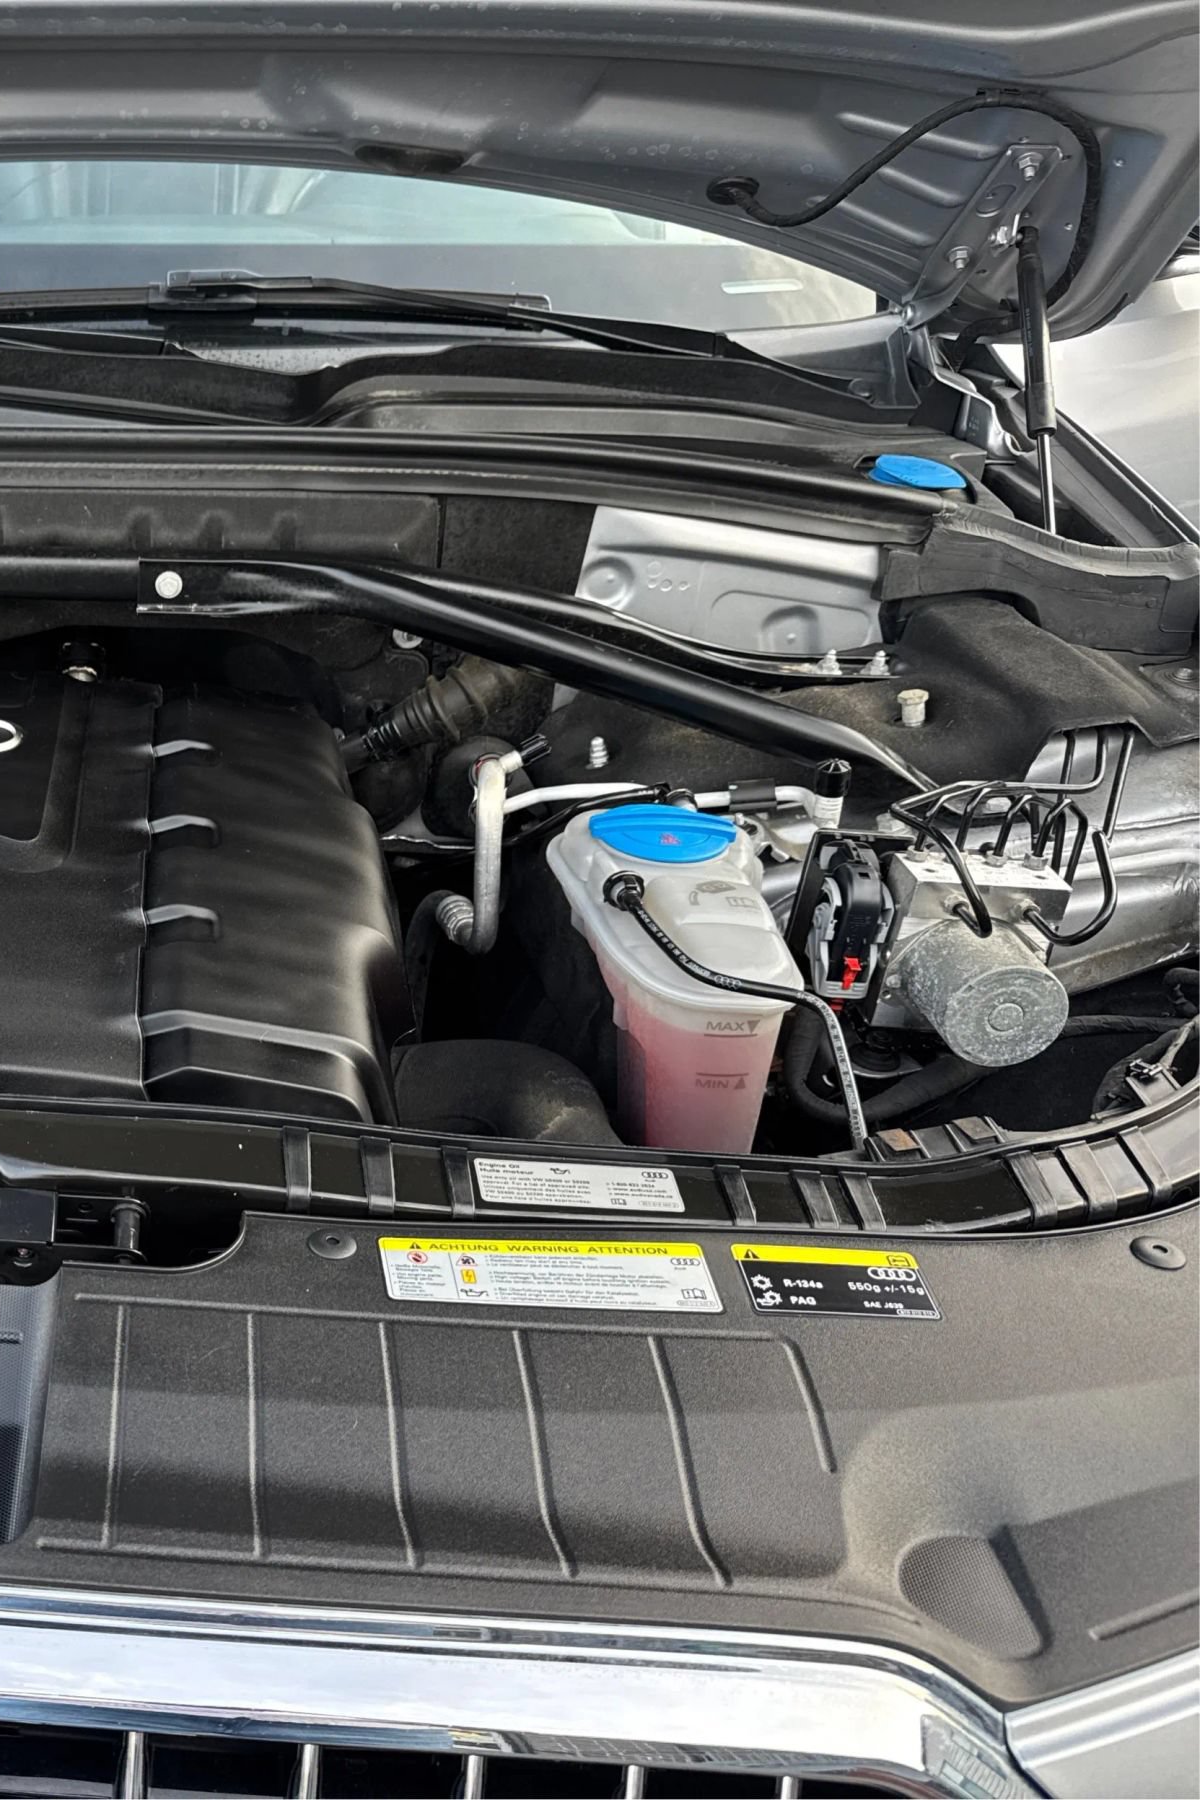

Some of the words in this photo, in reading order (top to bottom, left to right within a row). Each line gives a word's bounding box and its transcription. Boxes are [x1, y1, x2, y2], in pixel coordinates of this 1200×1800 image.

[706, 1021, 744, 1031] MAX
[695, 1078, 729, 1088] MIN
[429, 1243, 499, 1251] ACHTUNG
[507, 1244, 579, 1253] WARNING
[588, 1246, 668, 1255] ATTENTION
[783, 1279, 824, 1289] R-134a
[847, 1281, 881, 1293] 550g
[789, 1296, 817, 1306] PAG
